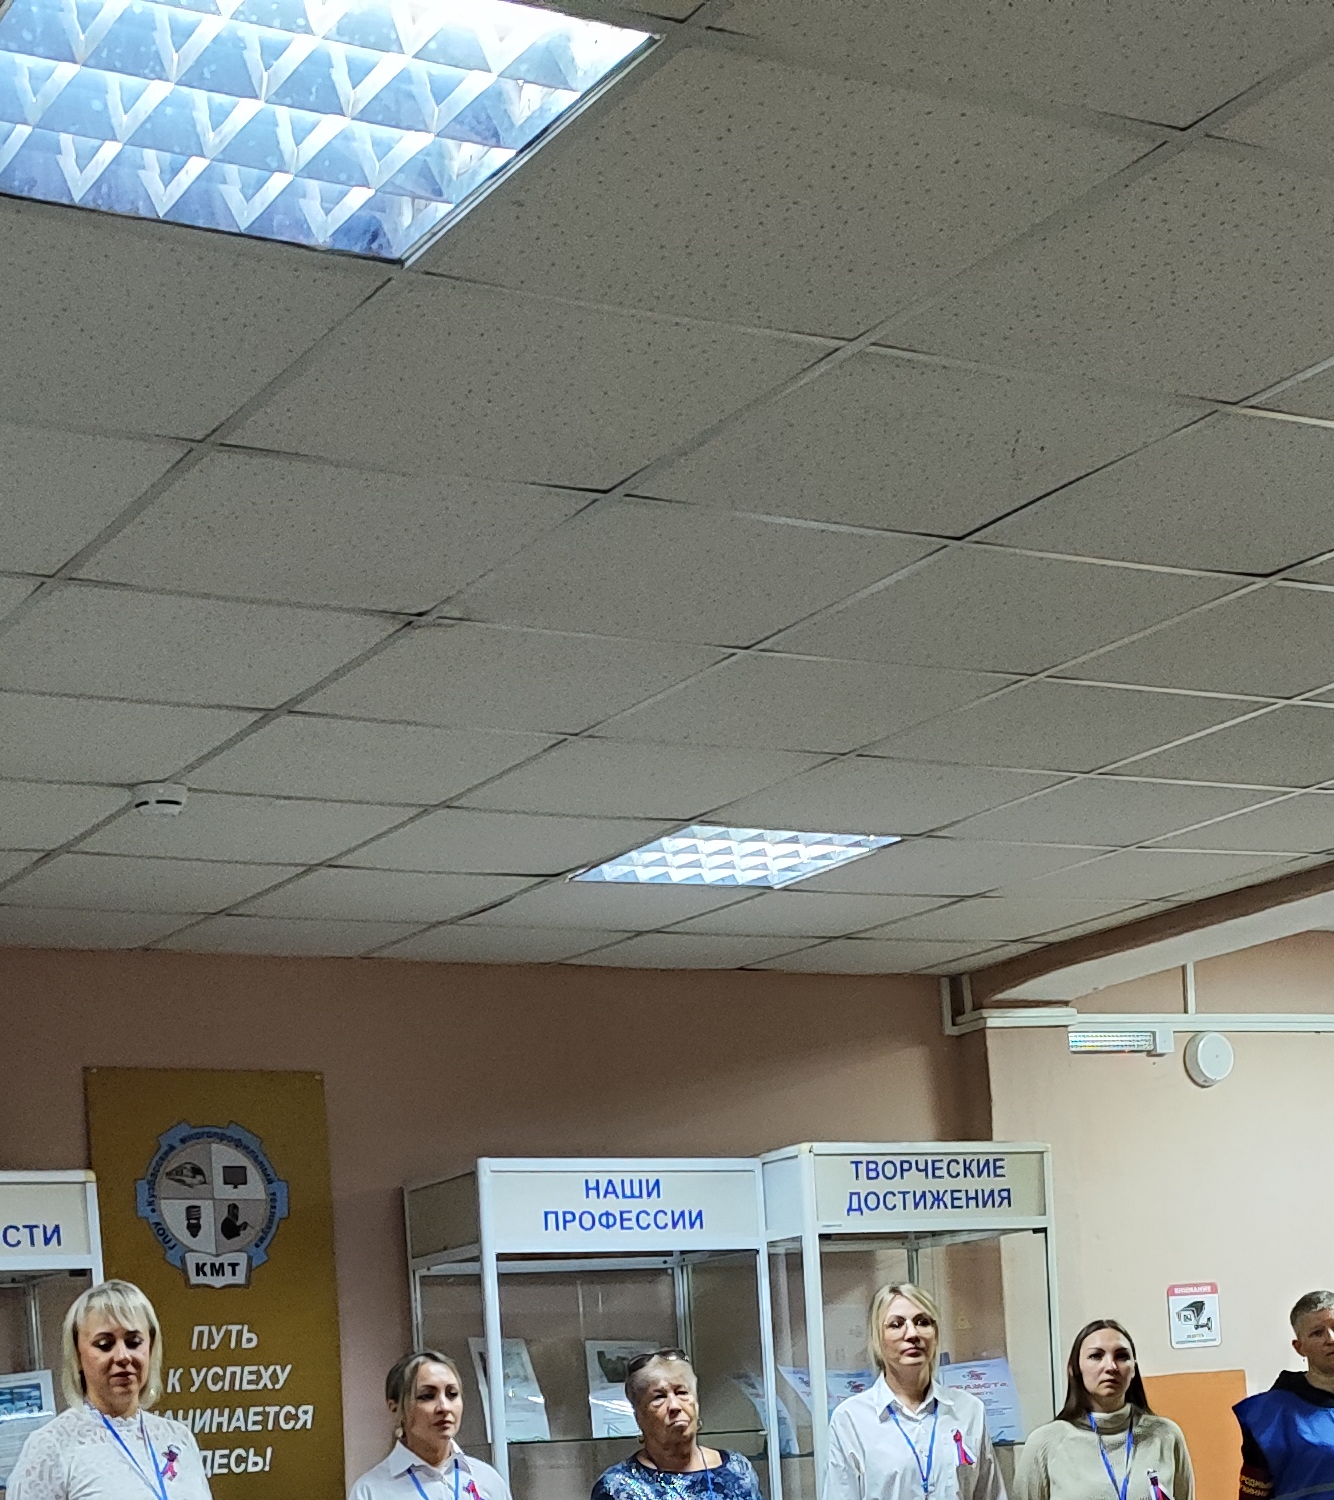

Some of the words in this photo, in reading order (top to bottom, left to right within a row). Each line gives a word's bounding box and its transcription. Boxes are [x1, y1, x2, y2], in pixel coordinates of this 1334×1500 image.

[850, 1158, 1006, 1180] ТВОРЧЕСКИЕ
[584, 1178, 661, 1200] НАШИ
[846, 1188, 1012, 1216] ДОСТИЖЕНИЯ
[543, 1209, 704, 1232] ПРОФЕССИИ
[152, 1221, 178, 1250] ГПОУ
[195, 1262, 240, 1278] КМТ
[191, 1324, 258, 1350] ПУТЬ
[167, 1367, 183, 1393] К
[189, 1364, 292, 1393] УСПЕХУ
[153, 1404, 314, 1434] ЧИНАЕТСЯ
[200, 1446, 273, 1478] ДЕСЬ!
